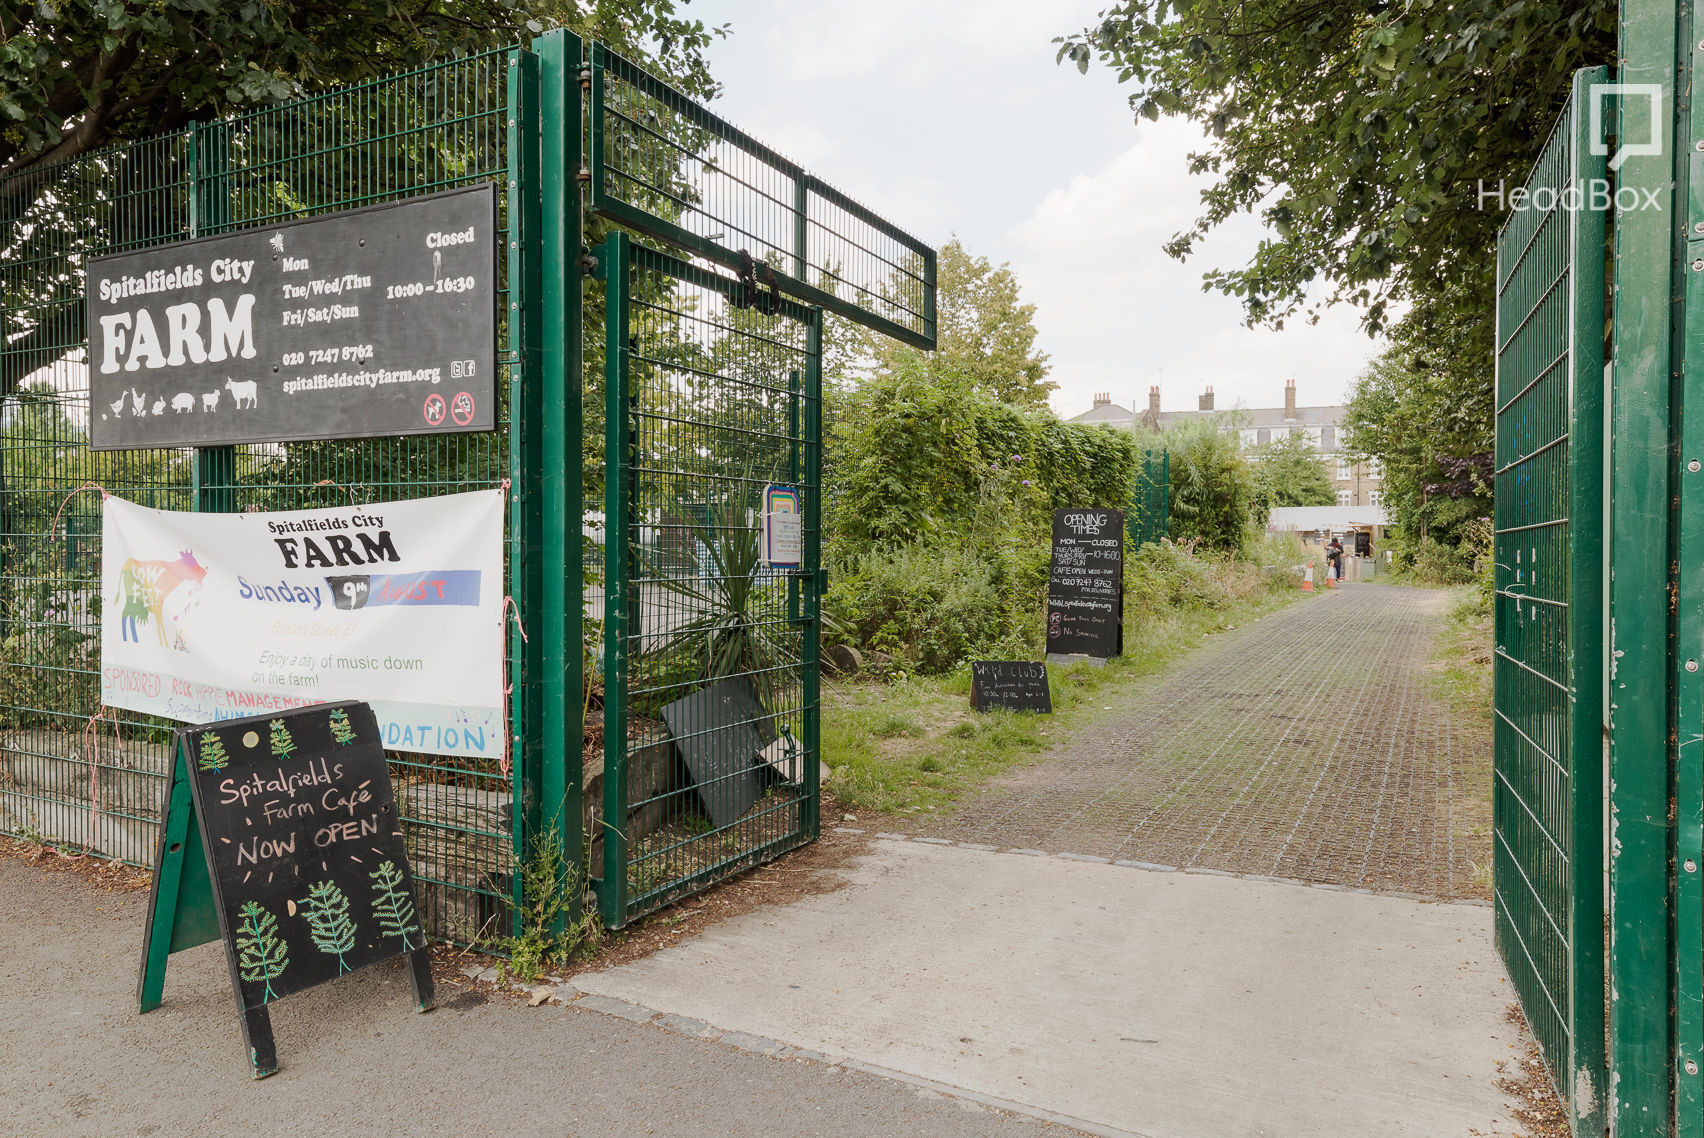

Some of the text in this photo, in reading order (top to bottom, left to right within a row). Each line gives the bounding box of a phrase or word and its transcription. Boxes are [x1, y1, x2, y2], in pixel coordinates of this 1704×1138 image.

[426, 226, 475, 250] Closed
[282, 256, 310, 274] Mon
[99, 258, 255, 304] Spitalfields City
[282, 274, 372, 300] Tue/Wed/Thu
[282, 305, 360, 327] Fri/Sat/Sun
[99, 293, 257, 375] FARM
[282, 344, 374, 367] 020 7247 8762
[282, 365, 441, 394] spitalfieldscityfarm.org
[268, 514, 385, 536] Spitalfields City
[1064, 513, 1108, 527] OPENING
[1069, 524, 1100, 535] TIMES
[274, 530, 401, 569] FARM
[1091, 539, 1118, 547] CLOSED
[238, 575, 321, 611] Sunday
[1093, 578, 1113, 589] 8762
[258, 650, 423, 671] Enjoy a day of music down
[1010, 665, 1038, 679] Club
[104, 667, 162, 698] SPONSORED
[251, 671, 321, 688] on the farm!
[219, 757, 344, 807] Spitalfields
[263, 779, 374, 825] Farm Café
[236, 814, 379, 867] NOW OPEN
